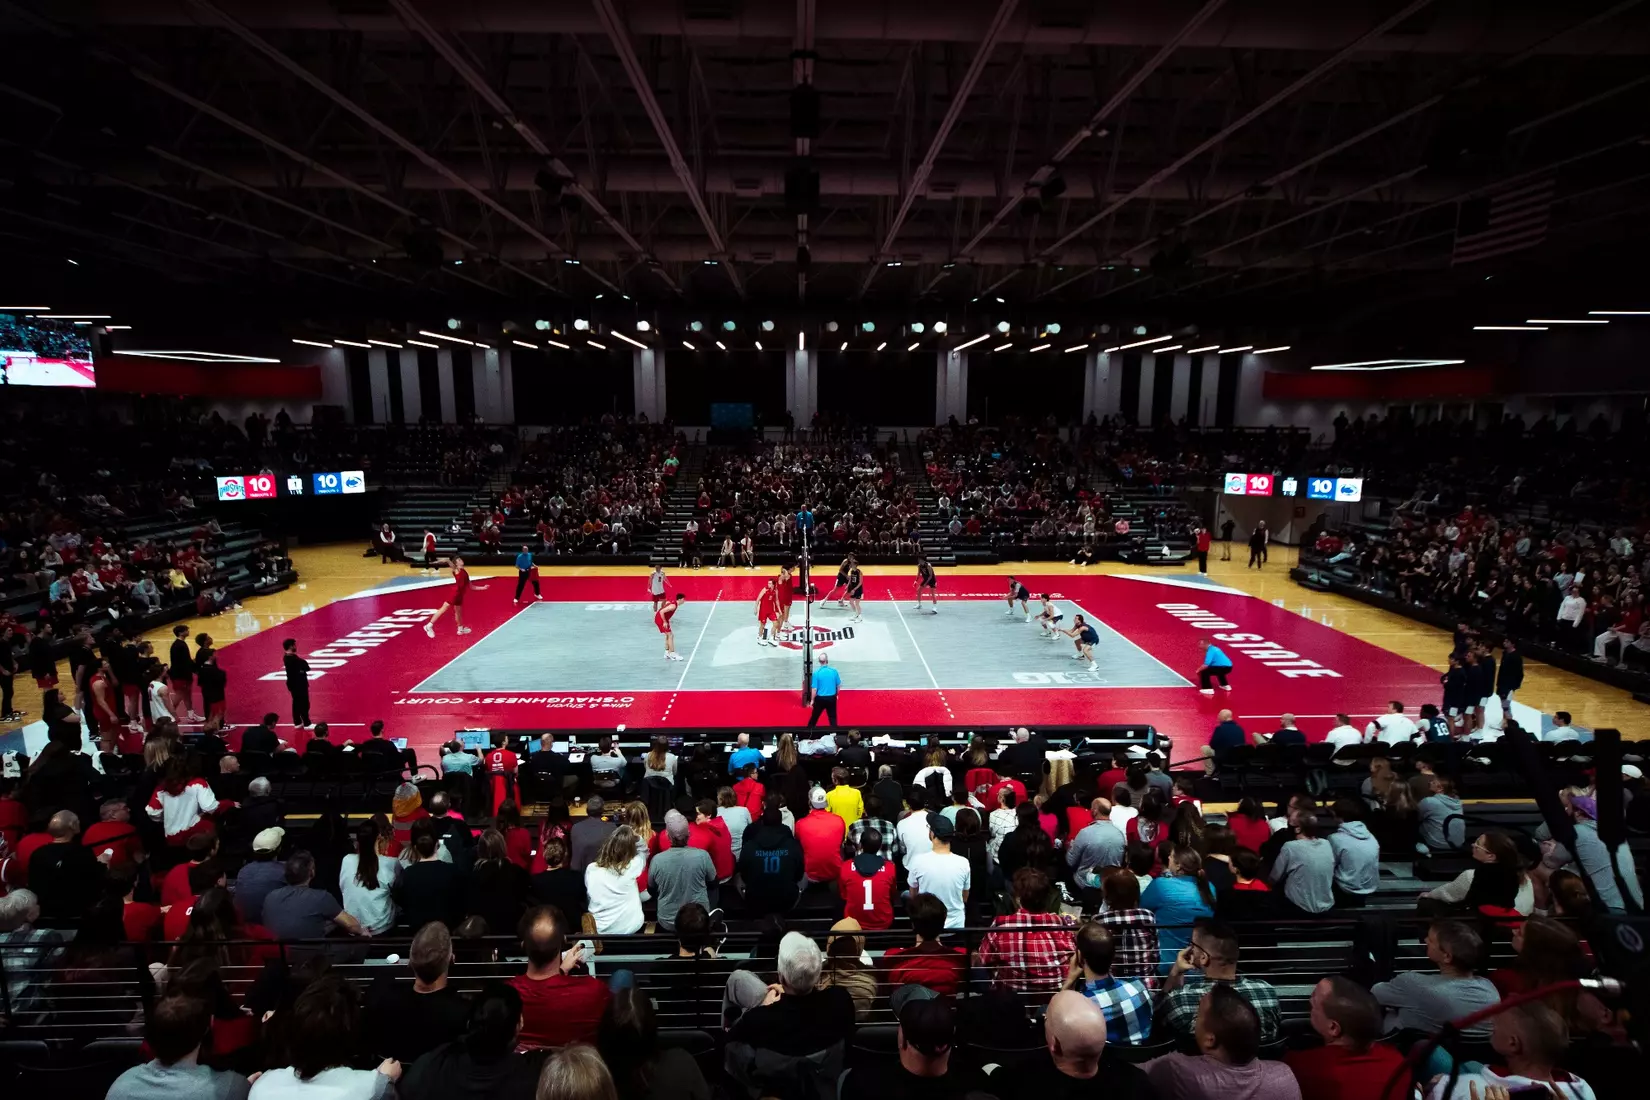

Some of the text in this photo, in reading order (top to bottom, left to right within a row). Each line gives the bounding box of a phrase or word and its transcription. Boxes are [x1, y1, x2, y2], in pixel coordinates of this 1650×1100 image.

[249, 477, 271, 492] 10
[318, 474, 338, 488] 10
[1250, 476, 1269, 490] 10
[1311, 479, 1333, 494] 10
[814, 626, 855, 642] OHIO
[1155, 603, 1344, 678] OHIO STATE
[393, 697, 464, 705] COURT
[1433, 722, 1450, 737] 18
[763, 856, 780, 874] 10
[862, 879, 874, 910] 1
